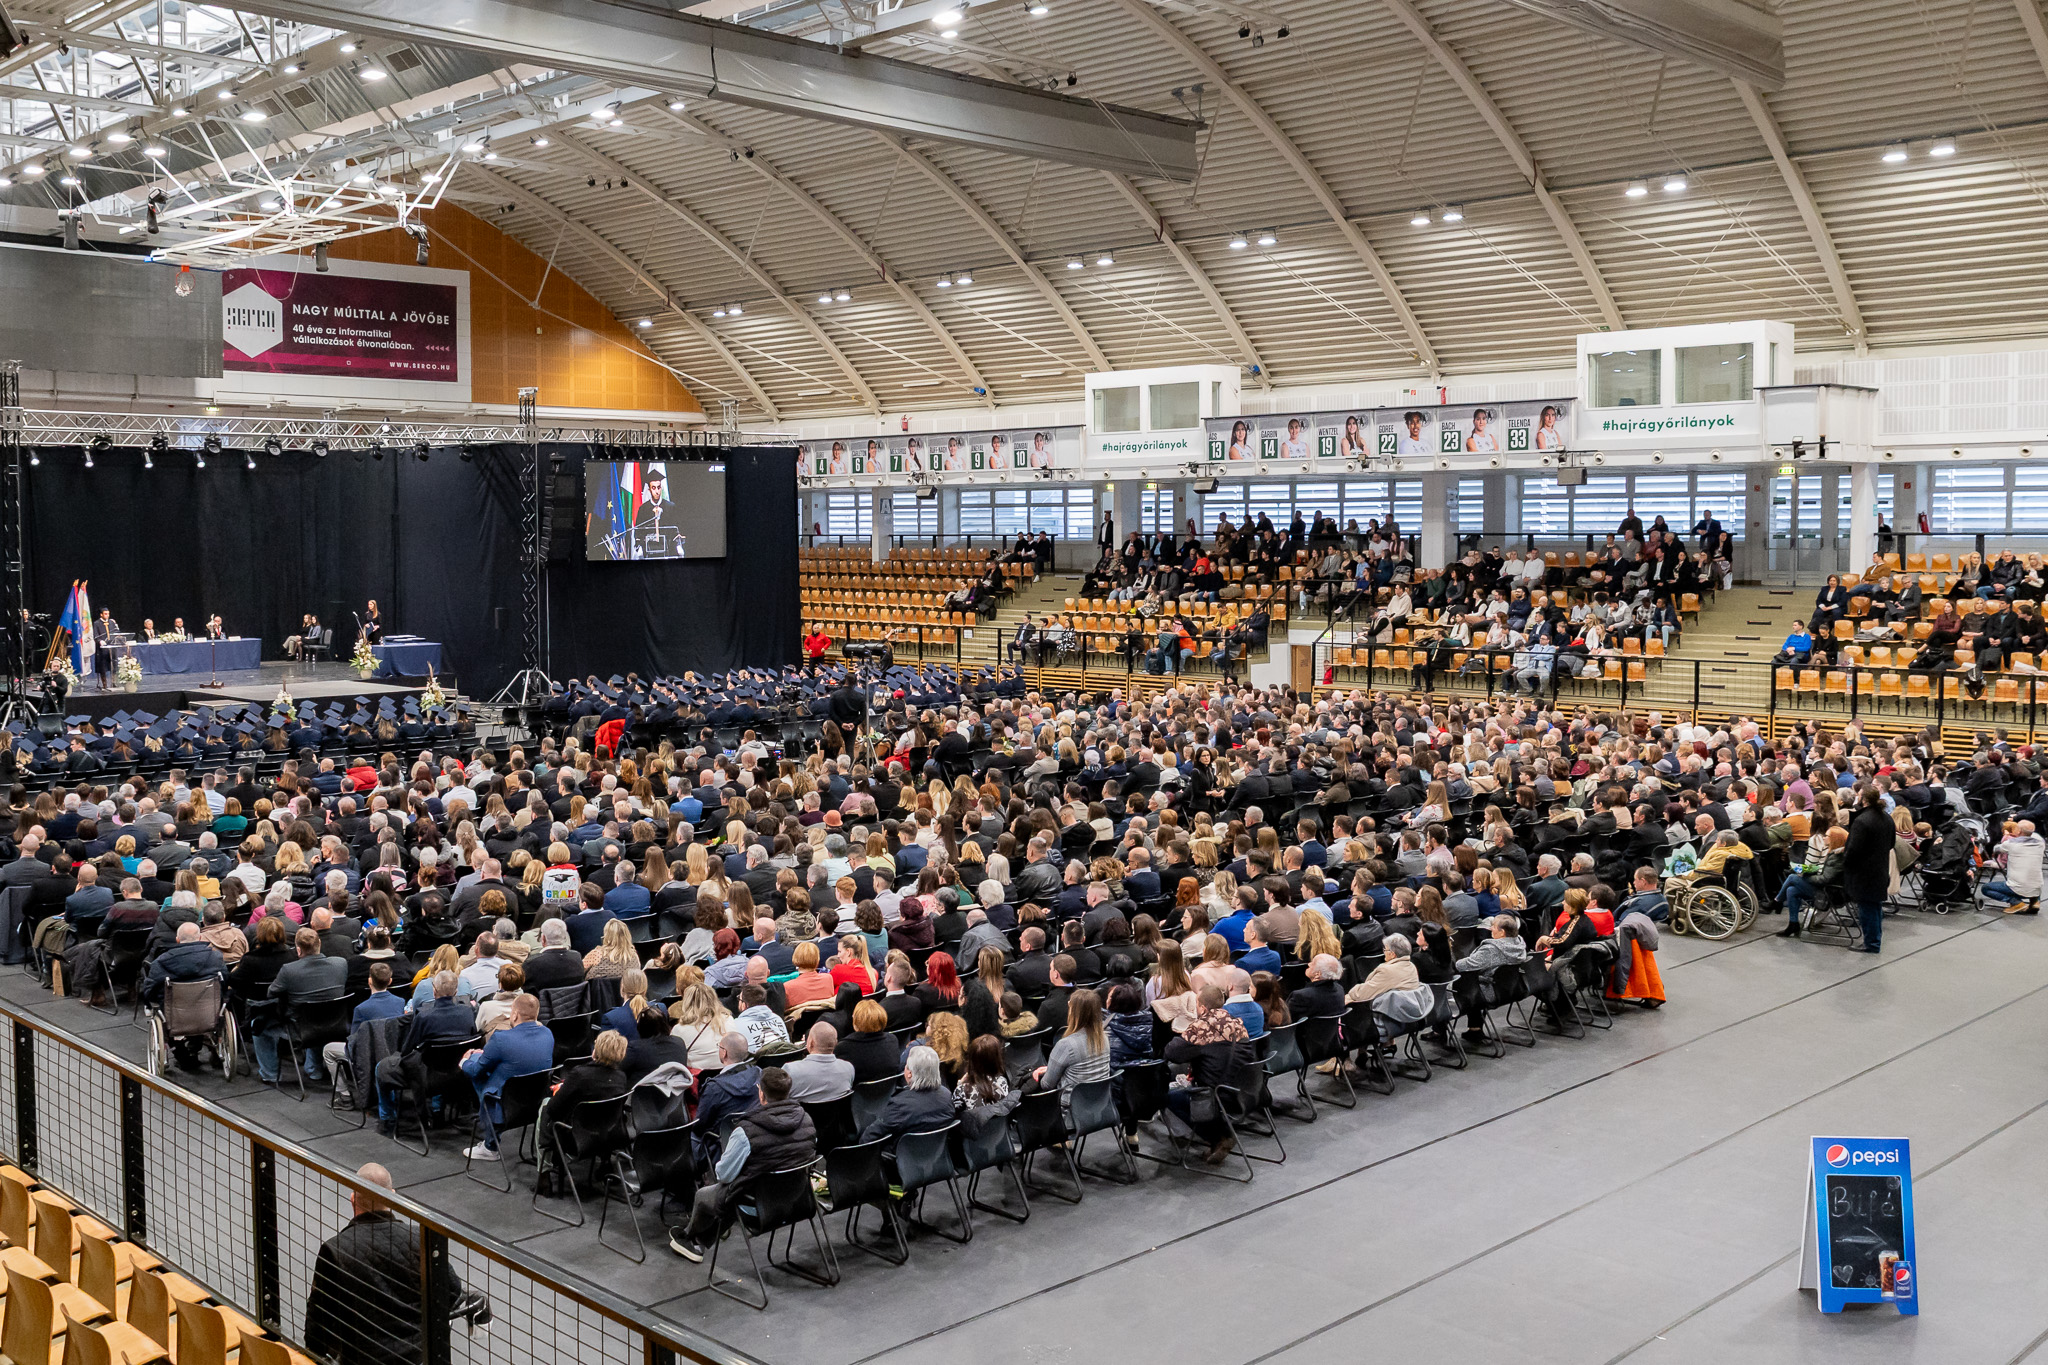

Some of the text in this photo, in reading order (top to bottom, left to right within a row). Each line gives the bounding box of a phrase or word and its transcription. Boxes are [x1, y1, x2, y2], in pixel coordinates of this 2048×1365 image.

[292, 304, 450, 325] NAGY MÚLTTAL A JÖVŐBE
[292, 324, 392, 339] 40 éve az informatikai
[292, 335, 415, 350] vállalkozások élvonalában.
[389, 361, 451, 370] WWW.SERCO.HU
[1508, 418, 1531, 428] TELENGA
[1602, 414, 1735, 433] #hajrágyőrilányok
[1321, 437, 1333, 455] 19
[1380, 434, 1395, 452] 22
[1443, 431, 1459, 450] 23
[1510, 429, 1527, 448] 33
[1211, 441, 1222, 459] 13
[1264, 439, 1275, 457] 14
[819, 459, 825, 473] 4
[855, 458, 861, 472] 6
[893, 456, 899, 470] 7
[933, 454, 939, 469] 8
[974, 453, 981, 468] 9
[1016, 451, 1025, 466] 10
[1852, 1149, 1899, 1166] pepsi
[1832, 1186, 1899, 1224] Büfé
